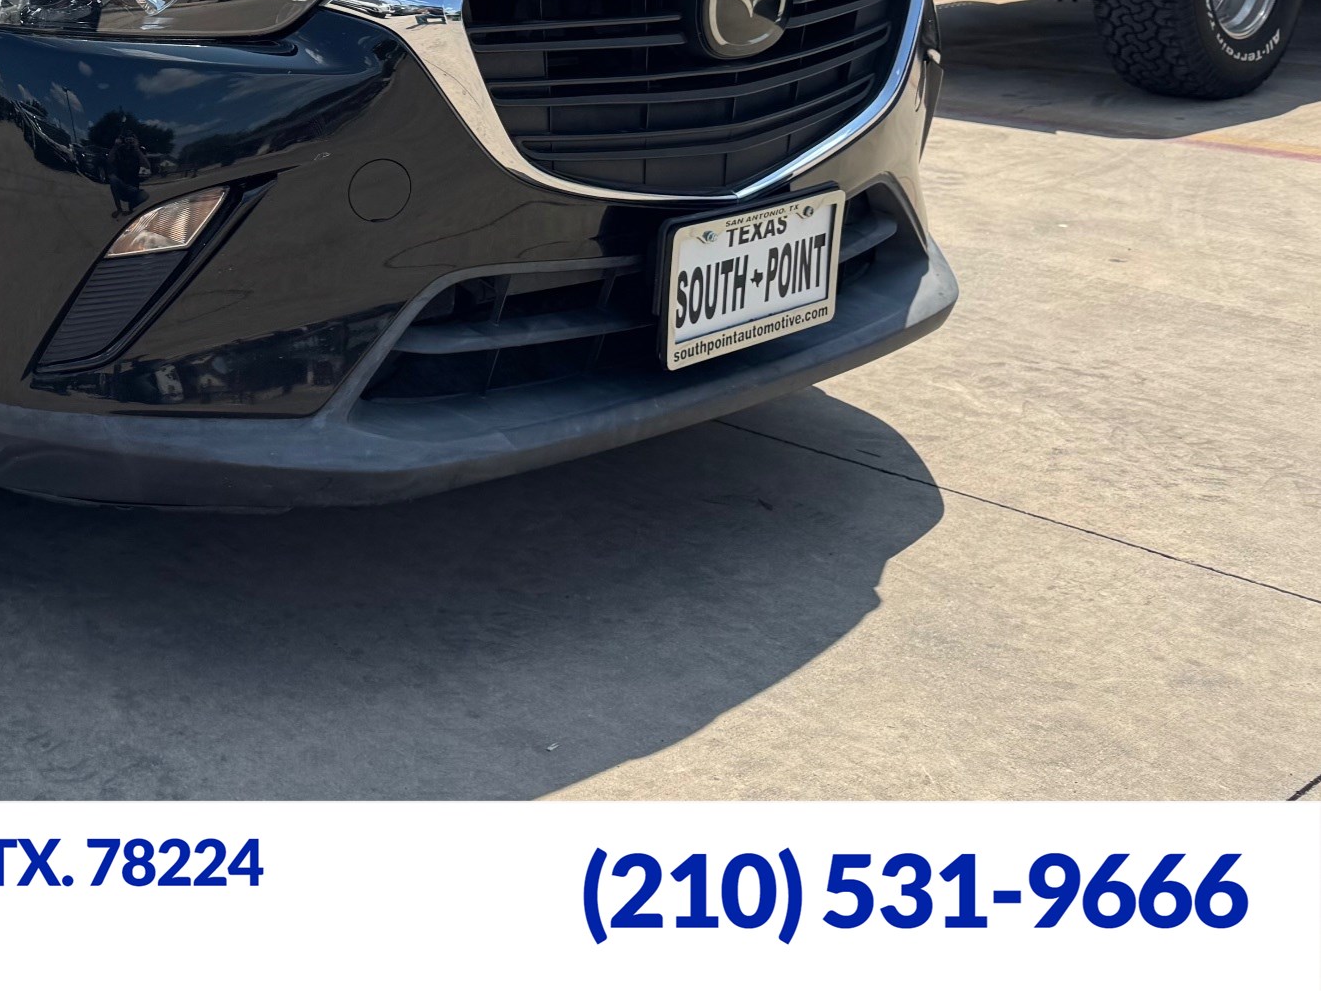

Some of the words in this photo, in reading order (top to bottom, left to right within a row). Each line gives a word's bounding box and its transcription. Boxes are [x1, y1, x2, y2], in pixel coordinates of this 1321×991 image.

[725, 218, 744, 227] SAN
[789, 204, 799, 212] TX
[726, 215, 787, 247] TEXAS
[675, 254, 749, 329] SOUTH
[764, 233, 826, 303] POINT
[673, 306, 828, 362] southpointautomotive.com
